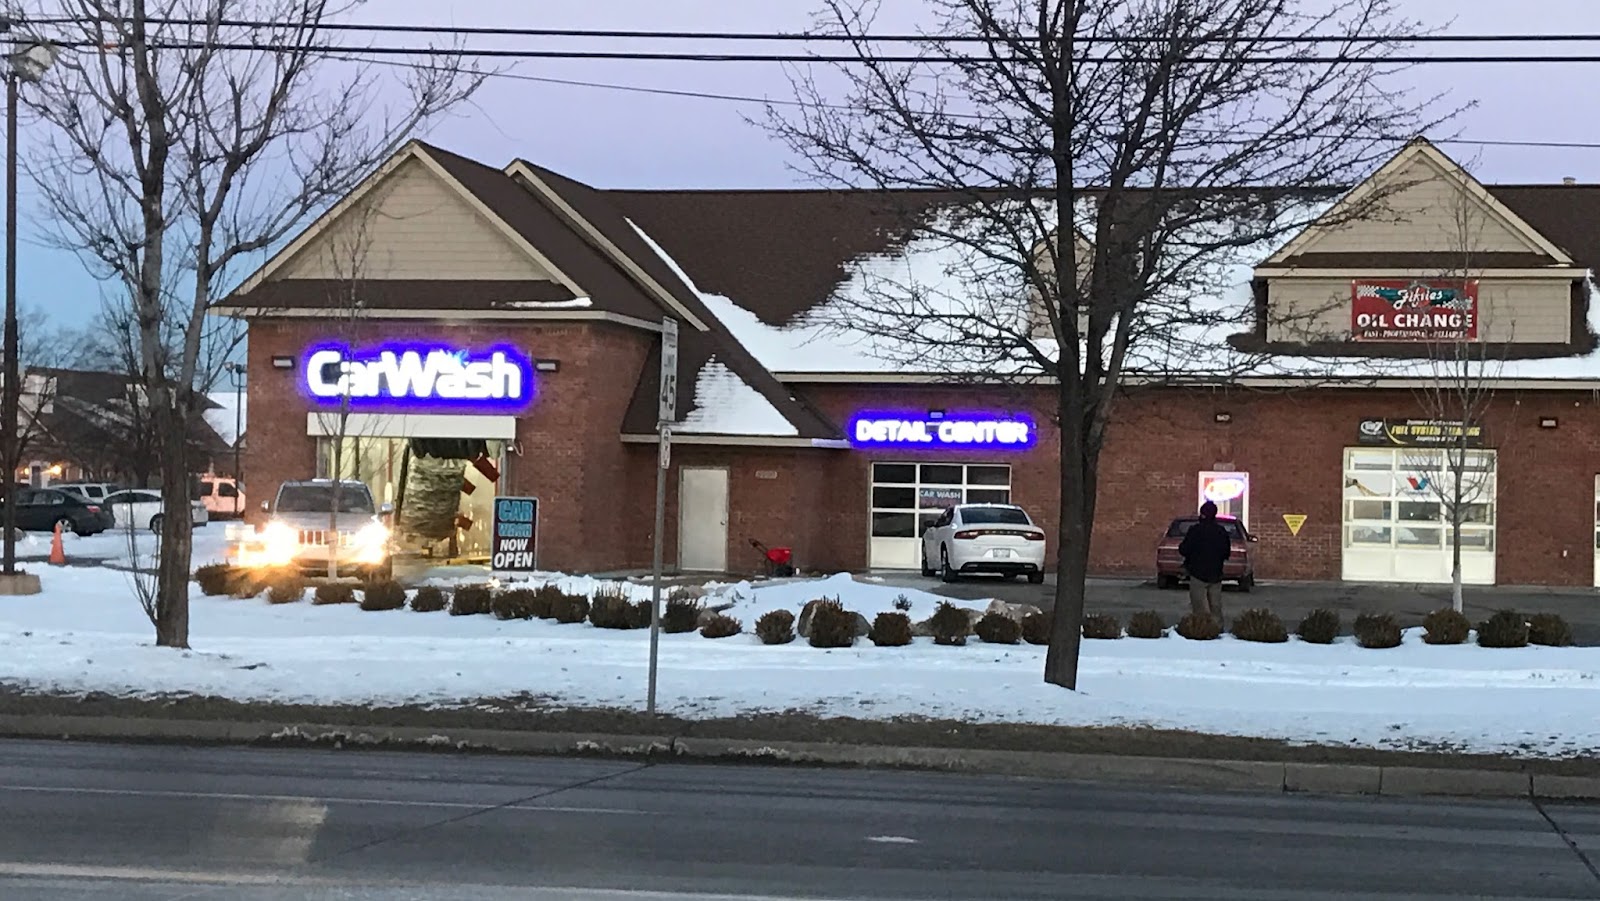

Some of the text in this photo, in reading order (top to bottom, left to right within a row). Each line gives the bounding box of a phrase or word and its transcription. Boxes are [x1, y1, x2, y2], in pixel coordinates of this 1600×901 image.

[1357, 313, 1473, 327] OIL CHANGE
[307, 350, 521, 398] CarWash
[661, 373, 675, 411] 45
[856, 420, 1029, 443] DETAIL CENTER
[937, 491, 961, 499] WASH
[498, 500, 534, 522] CAR
[500, 538, 529, 551] NOW
[494, 551, 533, 568] OPEN
